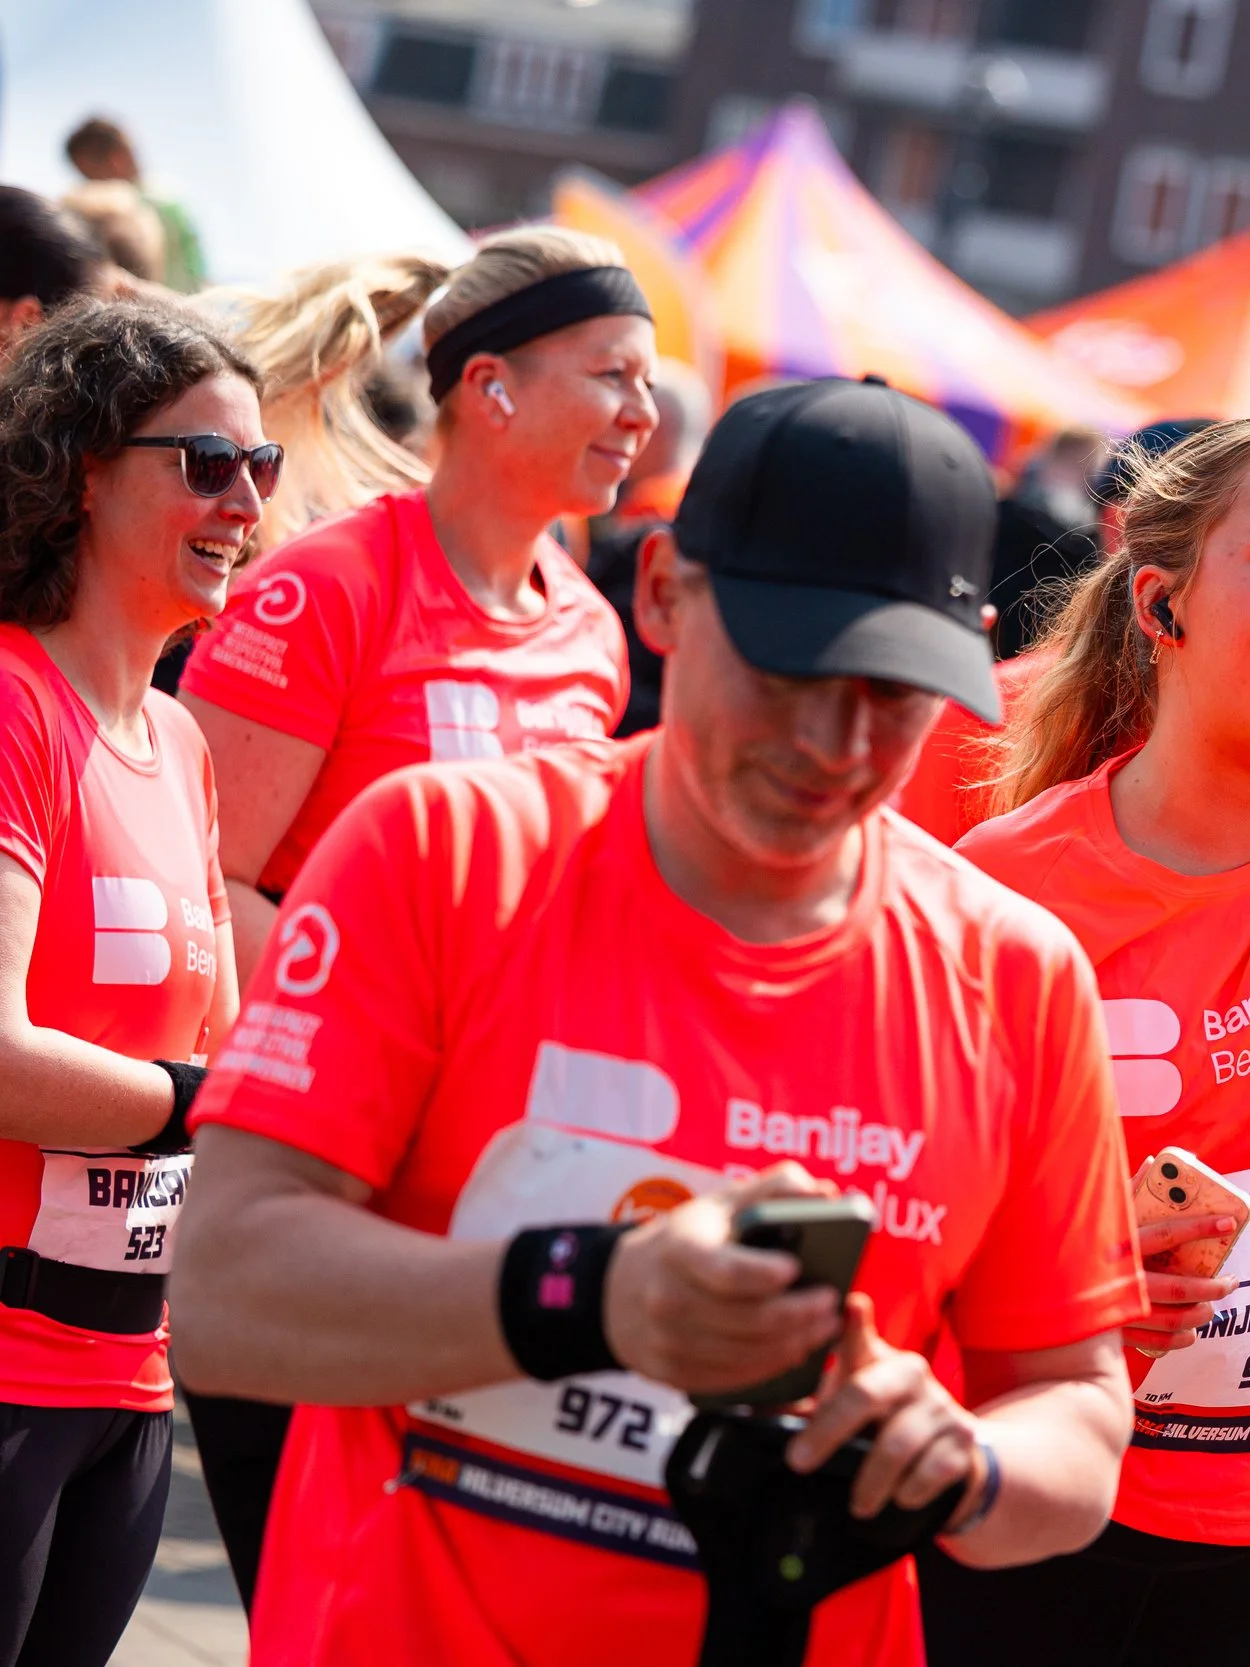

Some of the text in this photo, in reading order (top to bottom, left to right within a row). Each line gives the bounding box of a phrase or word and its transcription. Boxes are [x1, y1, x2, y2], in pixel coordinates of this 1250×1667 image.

[725, 1097, 926, 1181] Banijay
[124, 1225, 167, 1260] 523
[555, 1385, 655, 1452] 972
[1144, 1391, 1174, 1402] 10 KM
[457, 1462, 593, 1528] HILVERSUM
[590, 1501, 652, 1542] CITY
